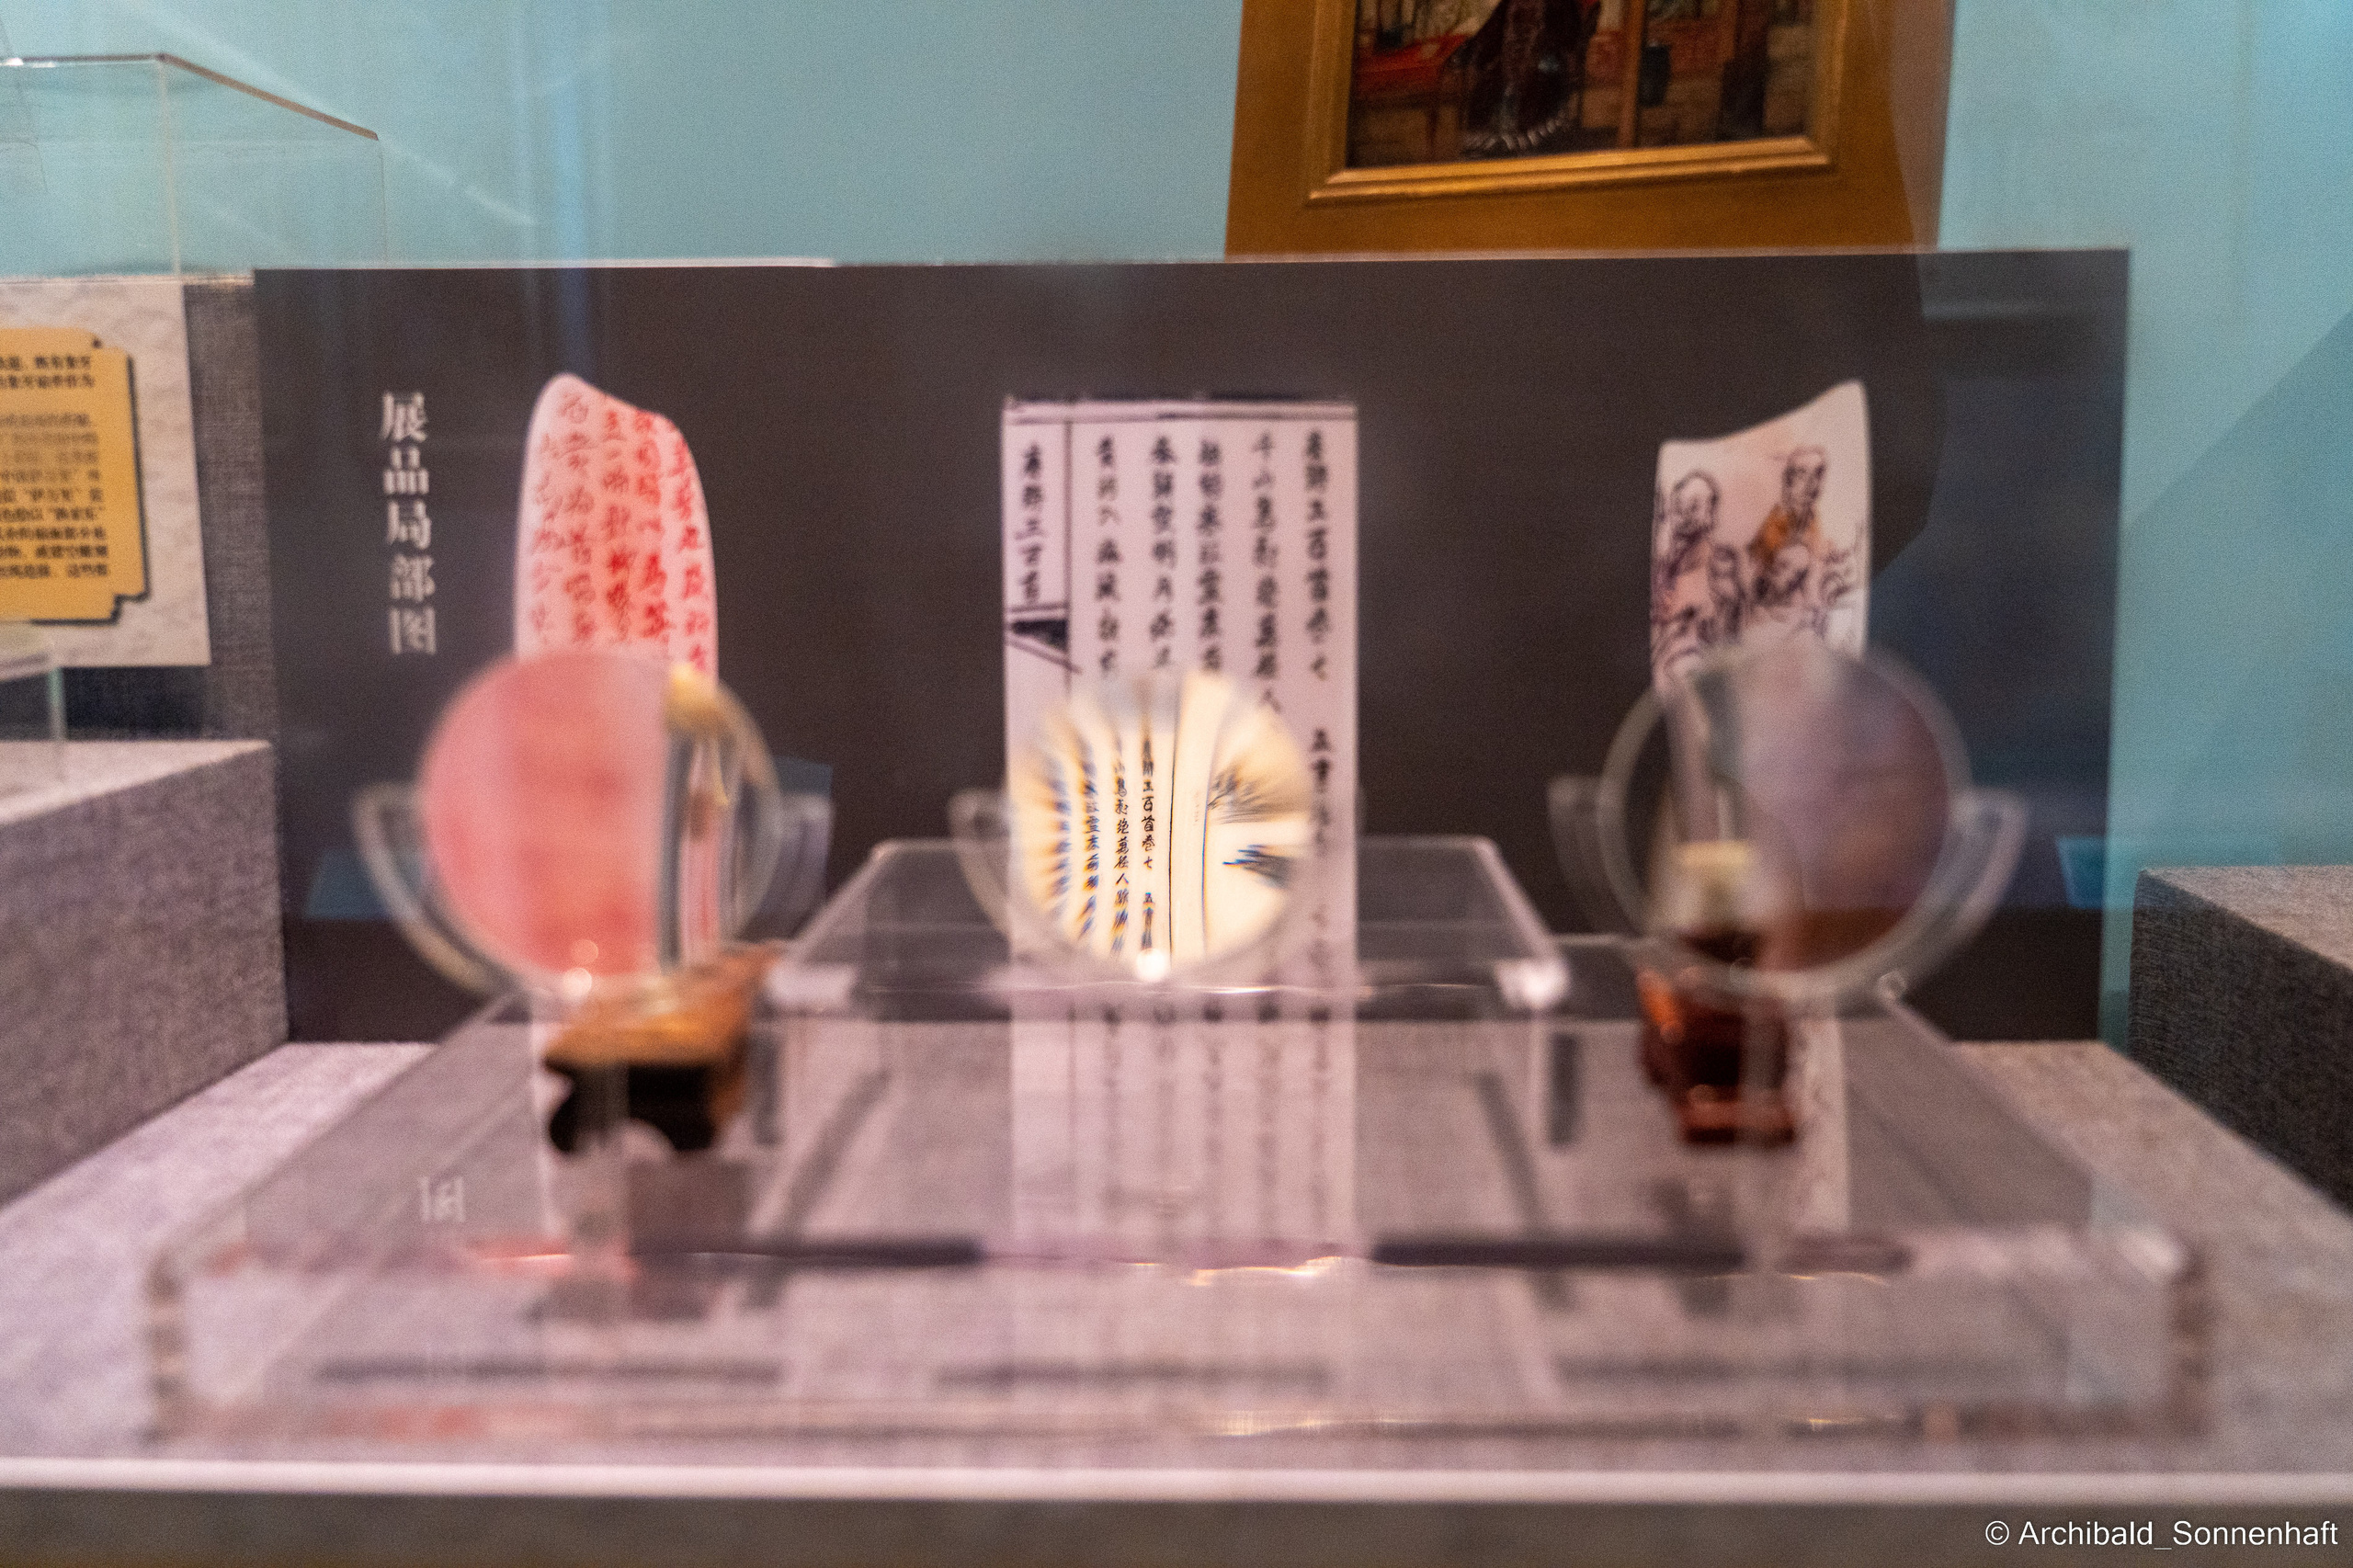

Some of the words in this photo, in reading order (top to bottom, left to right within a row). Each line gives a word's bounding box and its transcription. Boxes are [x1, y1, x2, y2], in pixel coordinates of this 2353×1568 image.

[379, 392, 438, 655] 展品局部图
